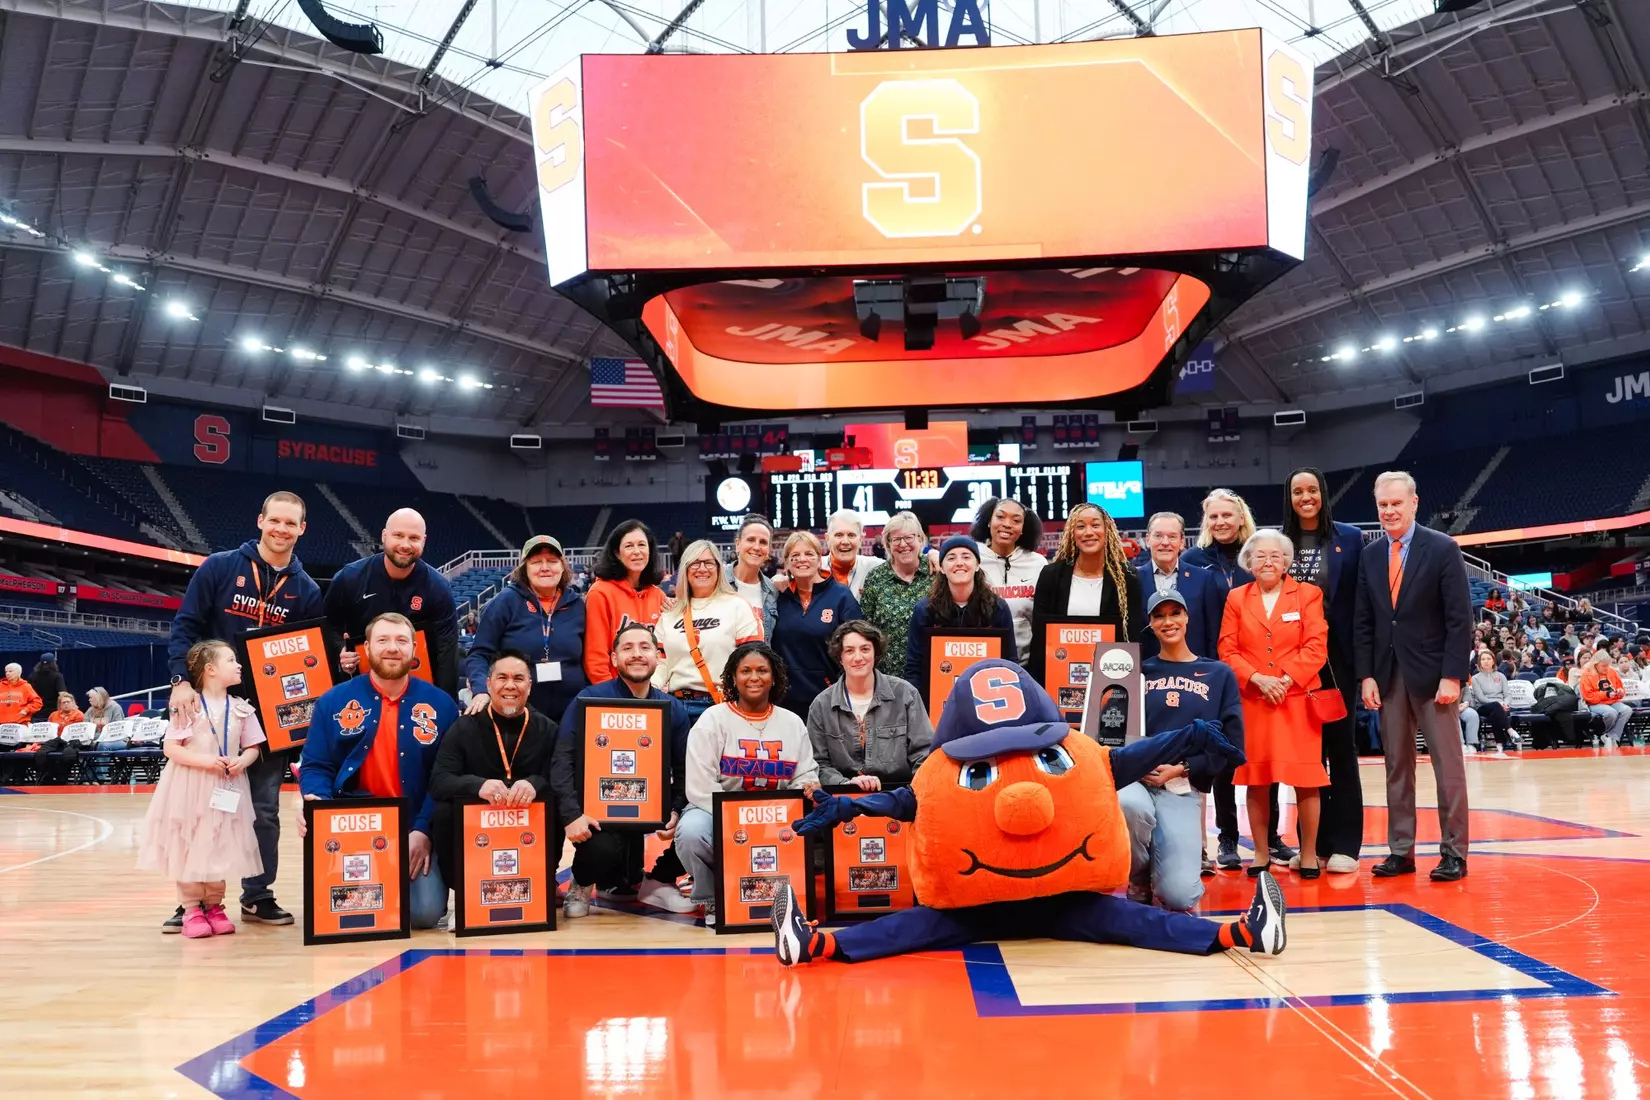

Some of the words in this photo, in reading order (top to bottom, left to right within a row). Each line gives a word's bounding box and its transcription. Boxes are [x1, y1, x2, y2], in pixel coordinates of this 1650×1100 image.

[846, 0, 990, 49] JMA
[725, 323, 860, 357] JMA
[976, 312, 1104, 351] JMA
[194, 414, 230, 464] S
[277, 439, 377, 467] SYRACUSE
[894, 439, 919, 469] S
[903, 470, 938, 489] 11:33
[852, 485, 874, 512] 41
[967, 482, 993, 509] 30
[265, 637, 305, 655] 'CUSE
[946, 643, 983, 656] 'CUSE
[1062, 630, 1098, 643] 'CUSE
[970, 667, 1026, 725] S
[602, 714, 642, 729] 'CUSE
[333, 814, 377, 831] 'CUSE
[482, 811, 525, 827] 'CUSE
[741, 807, 783, 823] 'CUSE
